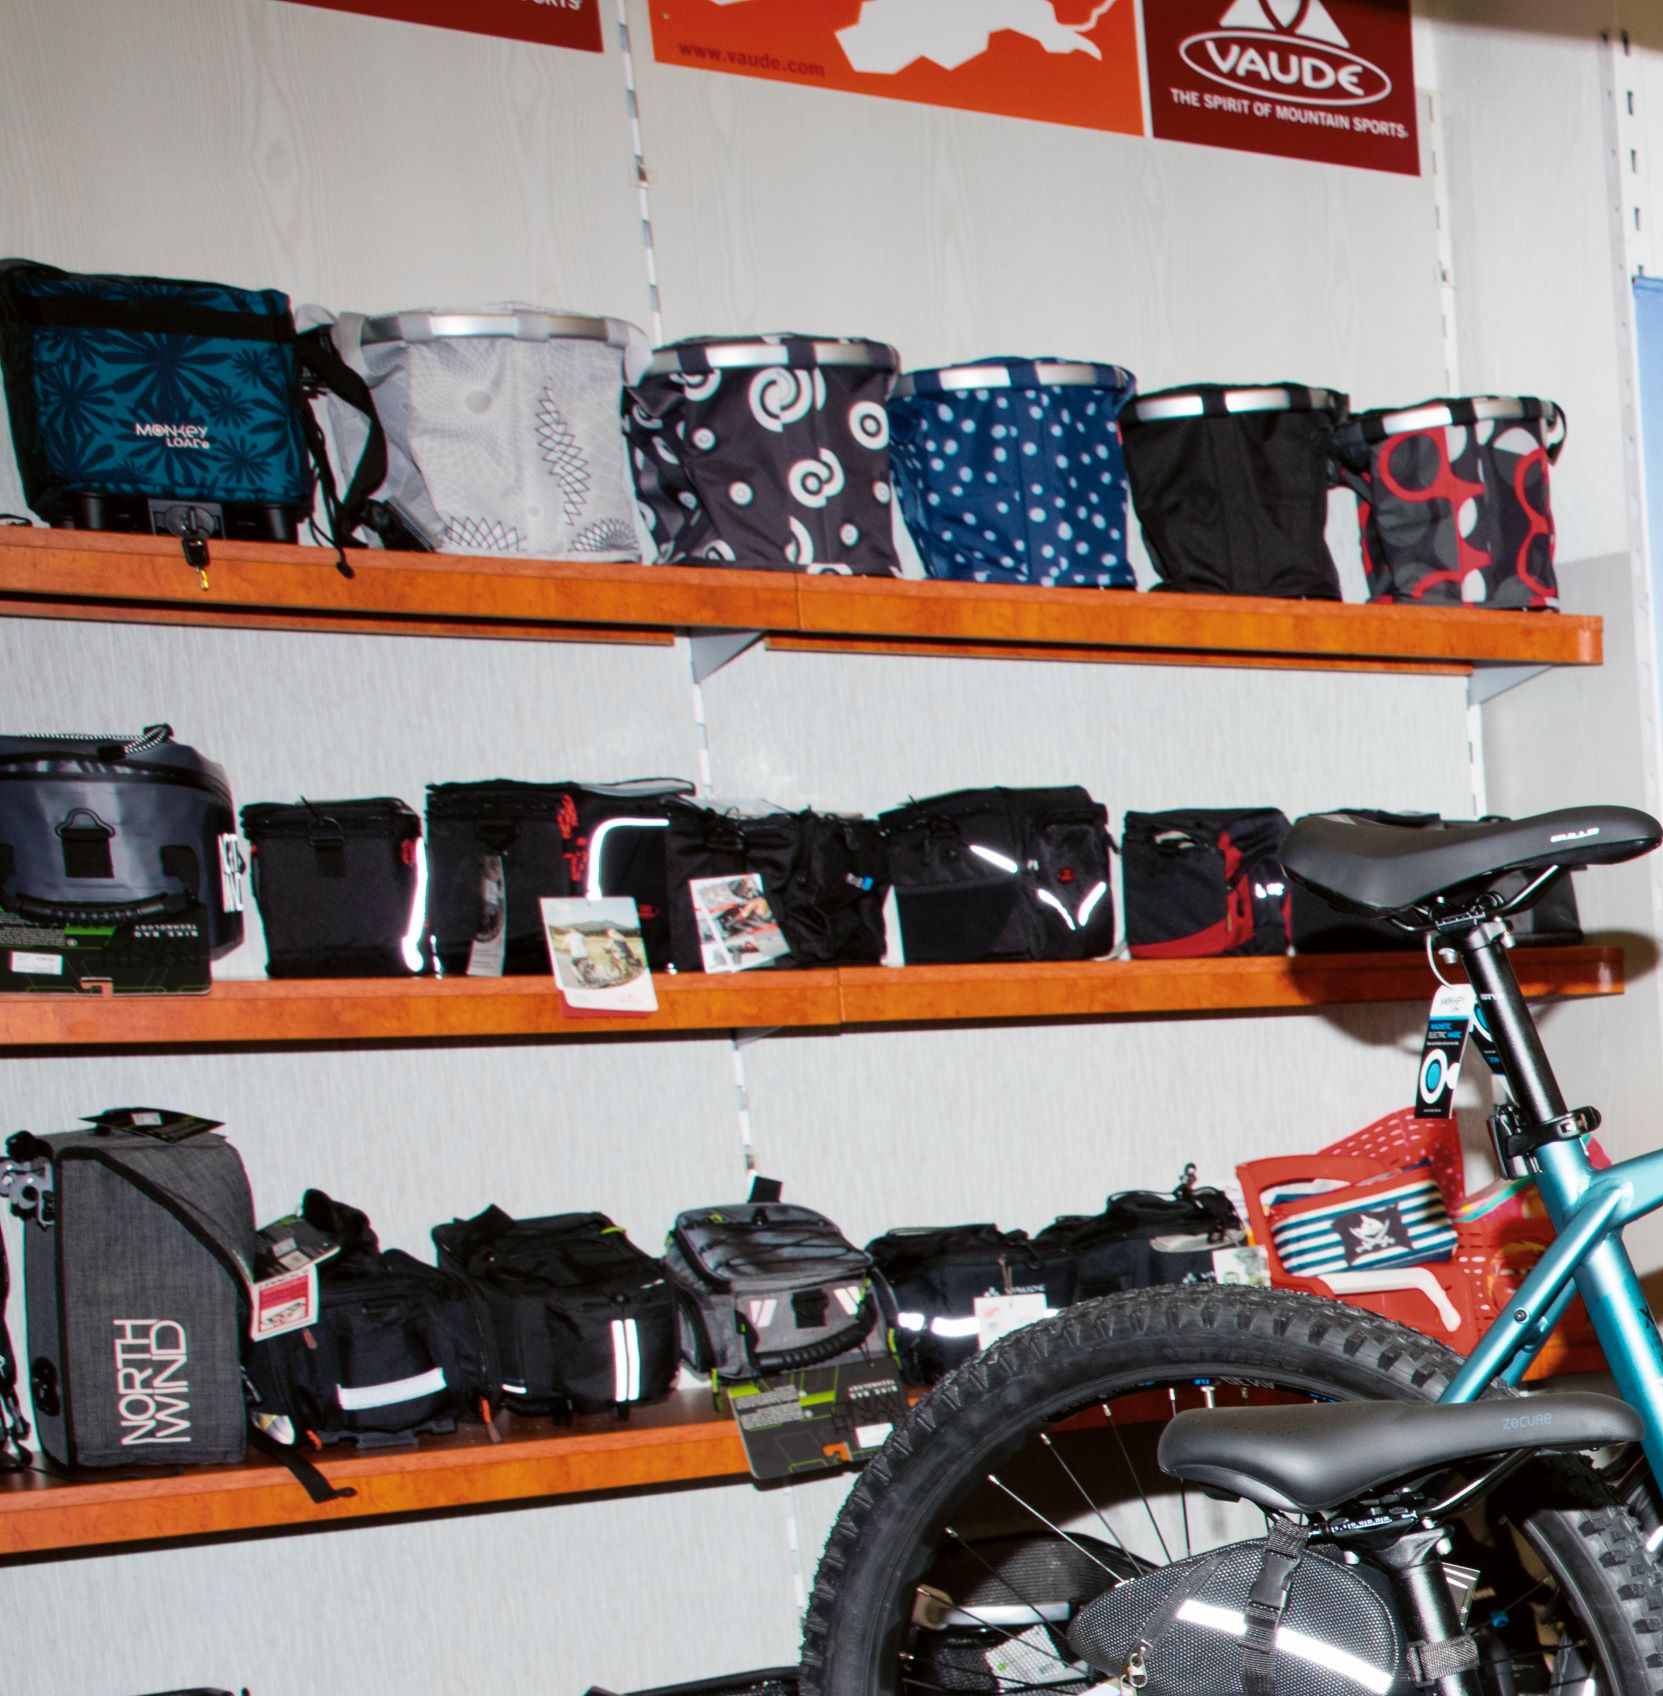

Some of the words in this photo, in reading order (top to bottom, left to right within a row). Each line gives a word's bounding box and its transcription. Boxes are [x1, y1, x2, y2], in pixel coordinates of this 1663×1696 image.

[676, 40, 827, 77] www.vaude.com
[1204, 39, 1365, 97] VAUDE
[1171, 88, 1201, 107] THE
[1203, 92, 1249, 114] SPIRIT
[1252, 100, 1273, 117] OF
[1276, 103, 1349, 131] MOUNTAIN
[1352, 114, 1406, 139] SPORTS
[114, 1319, 157, 1446] NORTH
[150, 1319, 191, 1443] WIND
